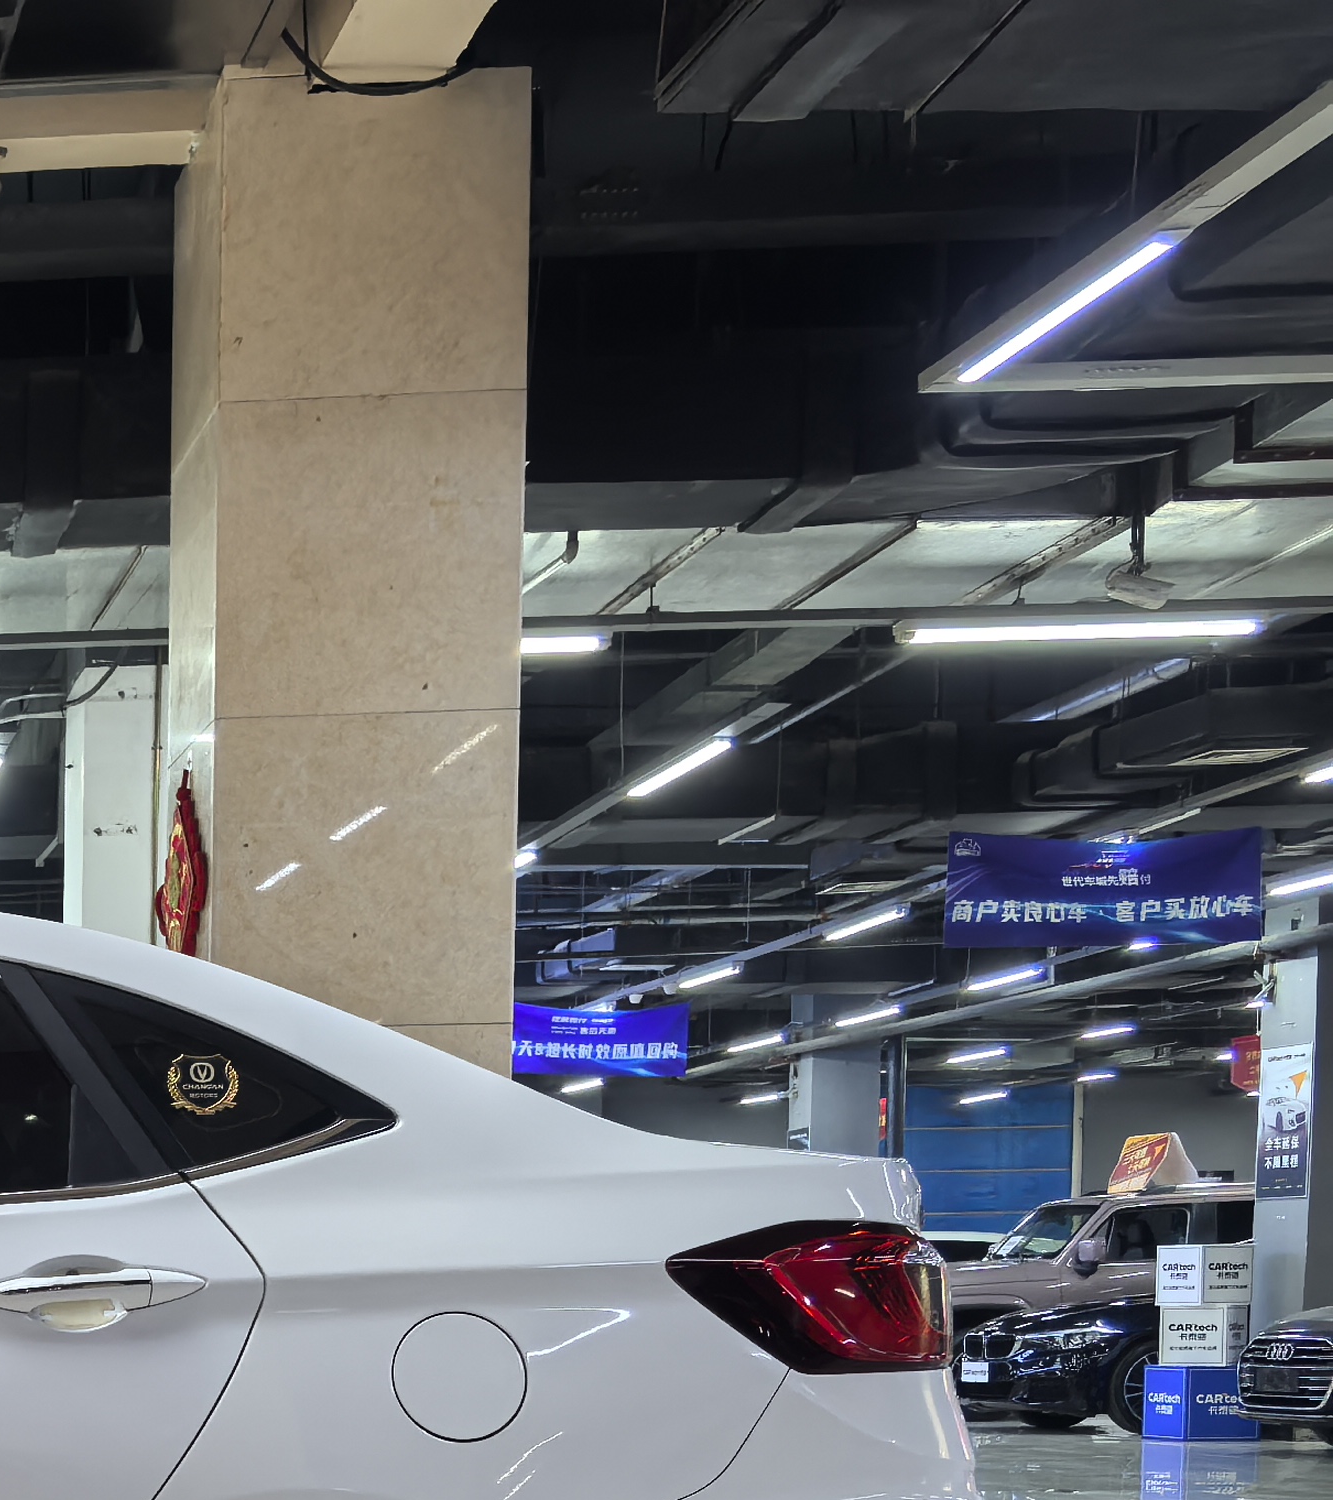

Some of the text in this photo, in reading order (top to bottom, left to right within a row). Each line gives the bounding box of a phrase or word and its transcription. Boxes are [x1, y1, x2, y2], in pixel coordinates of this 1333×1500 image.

[951, 894, 1254, 923] 商户卖良心车 客户买放心车
[512, 1040, 679, 1061] 天&超长时效原值回购
[1196, 1393, 1238, 1404] CARte
